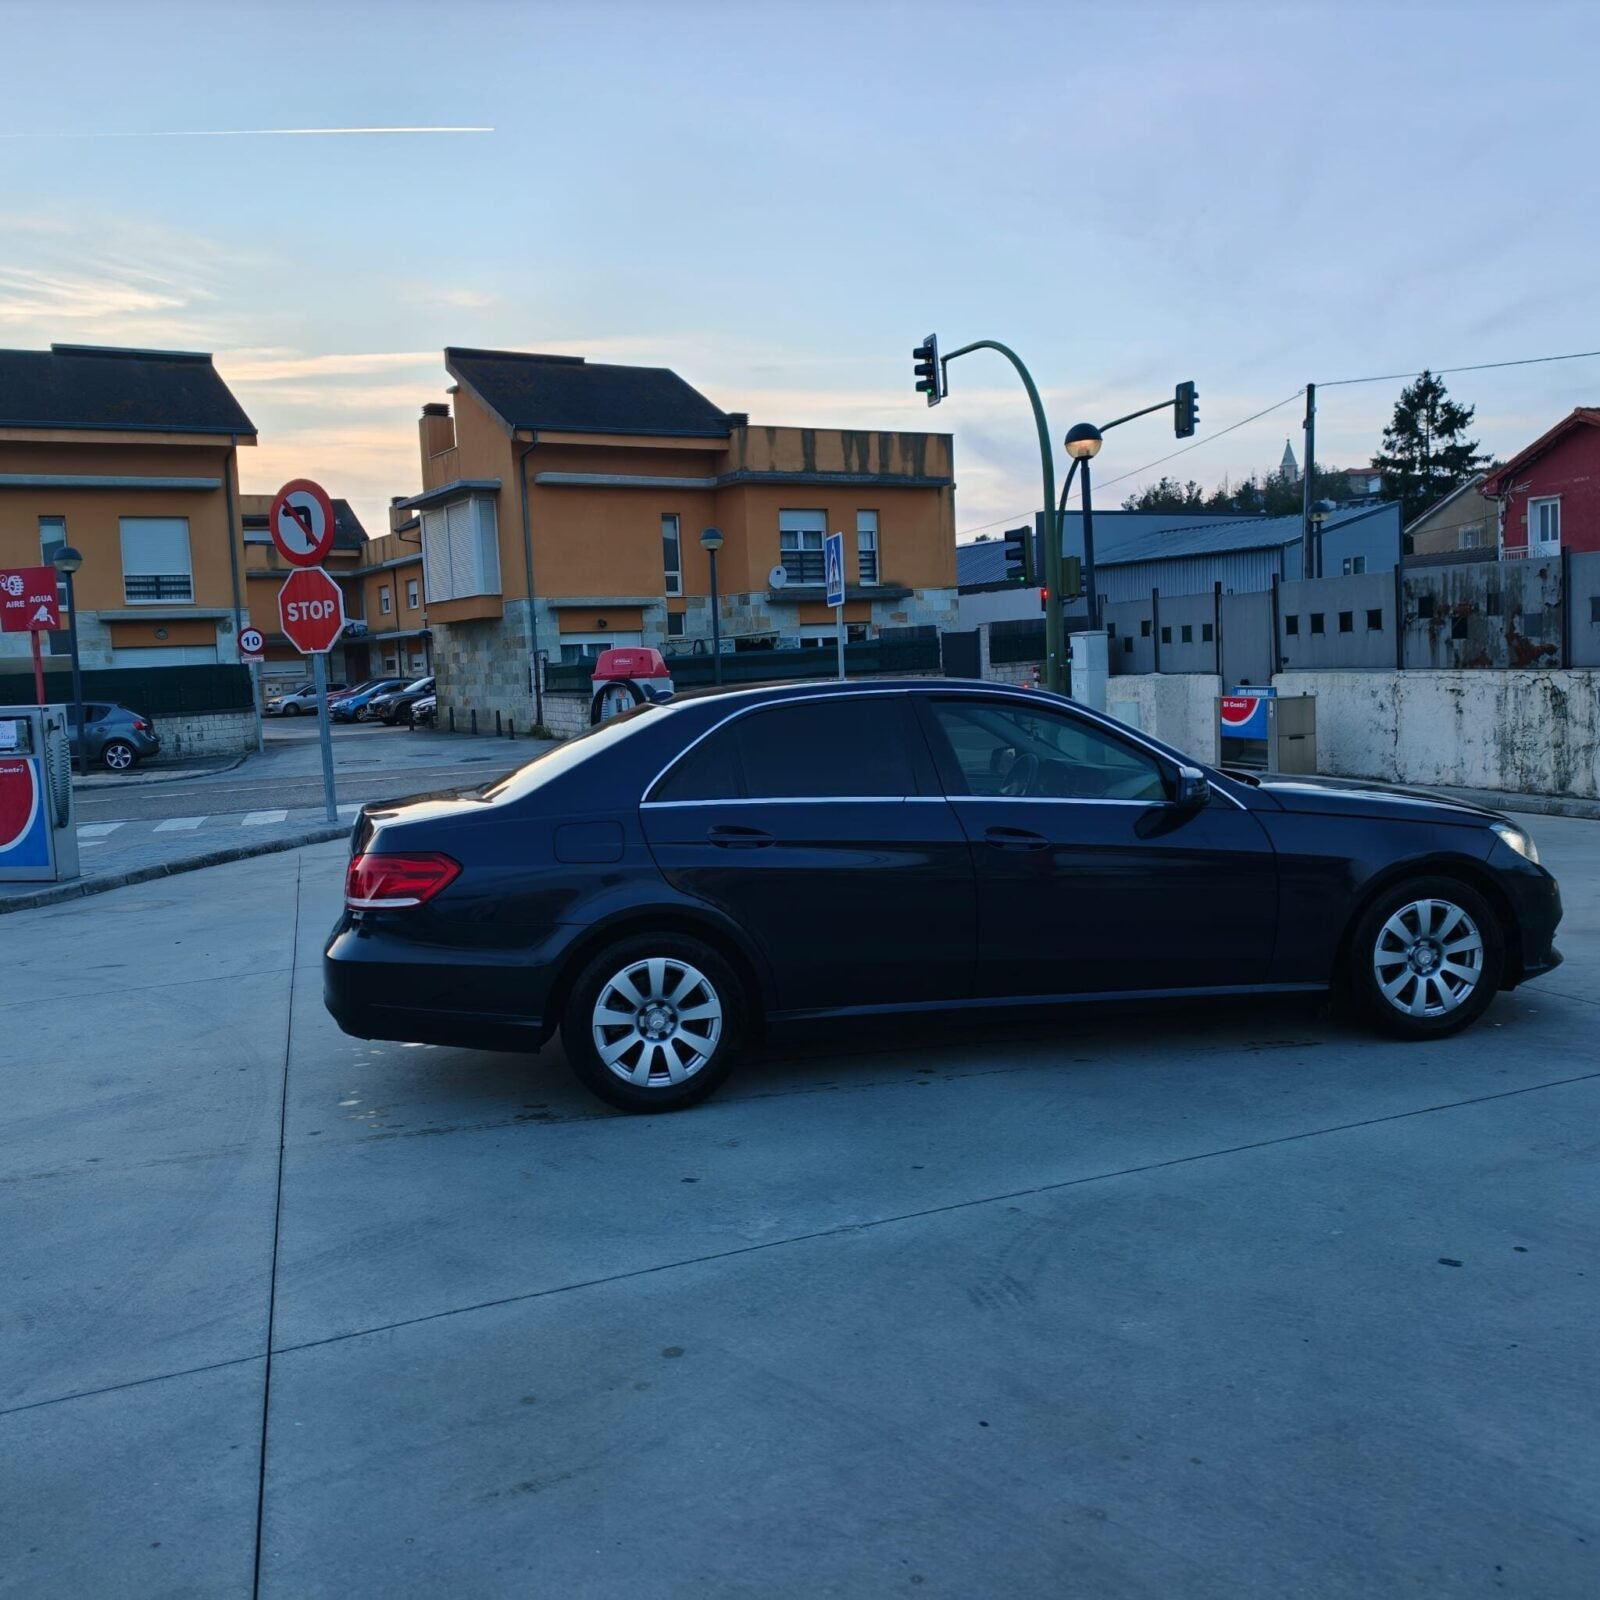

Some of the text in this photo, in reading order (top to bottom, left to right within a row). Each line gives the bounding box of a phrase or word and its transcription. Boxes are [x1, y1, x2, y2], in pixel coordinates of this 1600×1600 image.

[30, 595, 53, 603] AGUA
[6, 600, 25, 608] AIRE
[287, 600, 335, 621] STOP
[243, 636, 260, 646] 10
